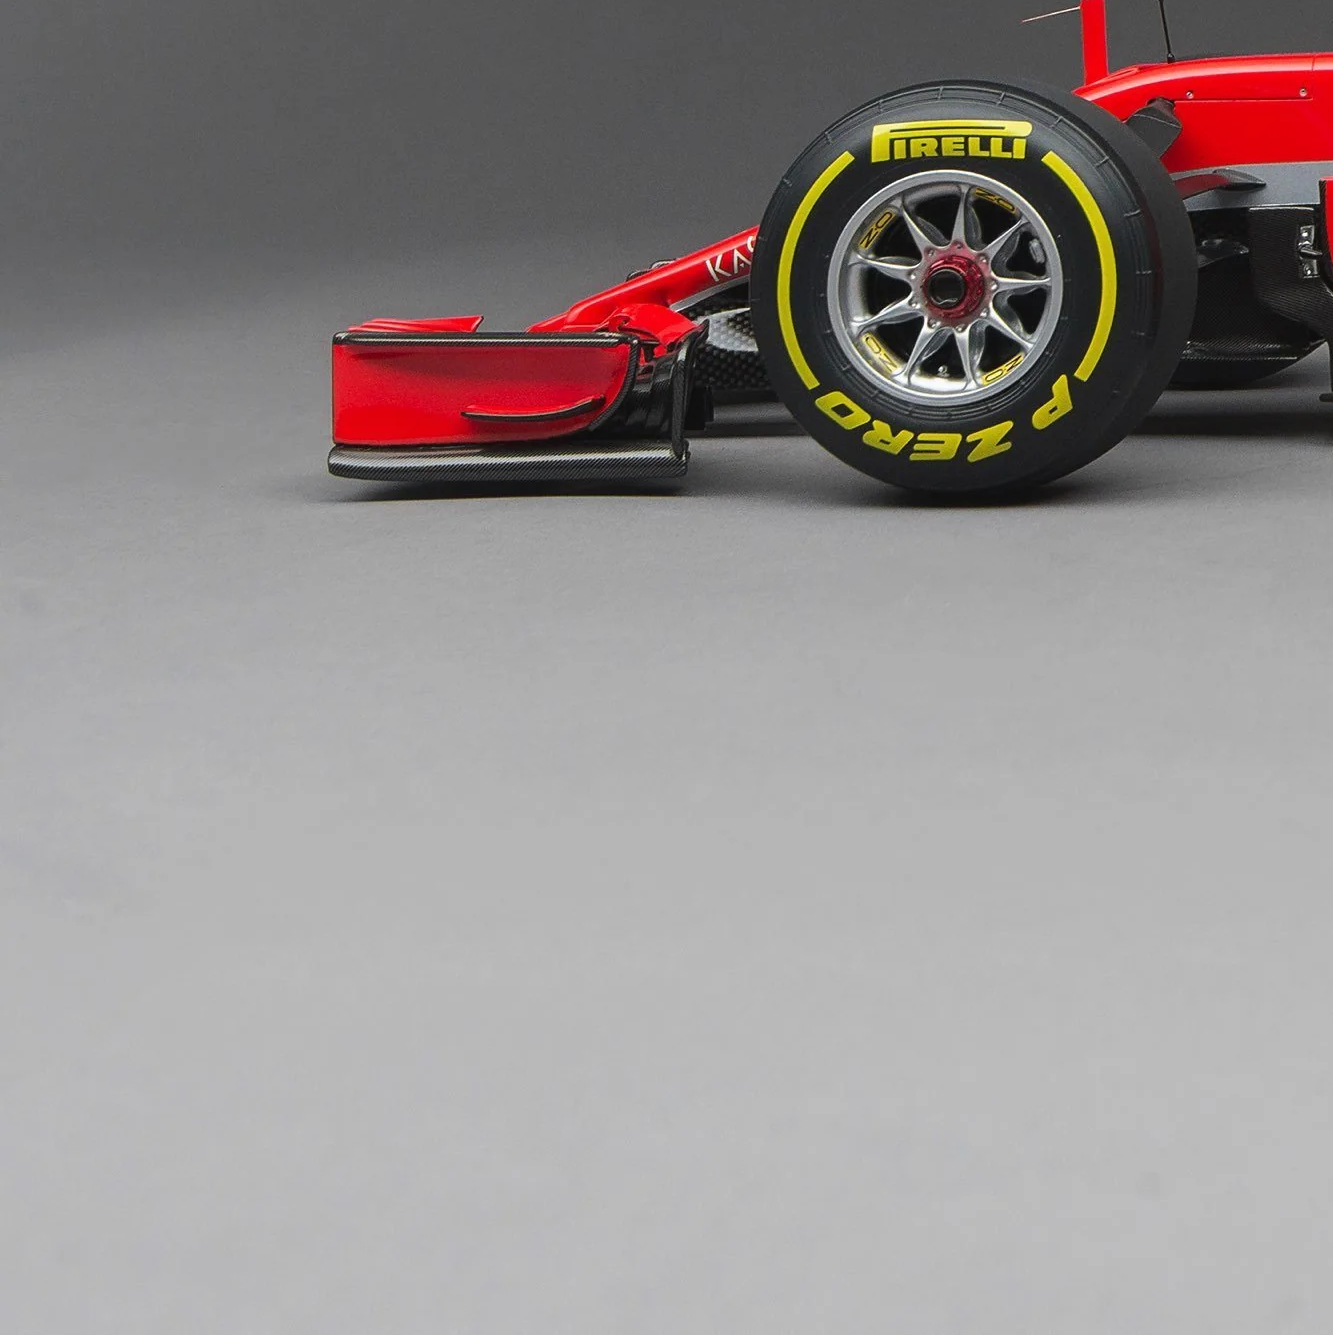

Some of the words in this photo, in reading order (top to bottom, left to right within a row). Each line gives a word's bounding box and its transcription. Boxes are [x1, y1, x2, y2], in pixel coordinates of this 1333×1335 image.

[871, 120, 1032, 163] PIRELLI
[815, 391, 1014, 463] ZERO
[1032, 374, 1073, 430] P
